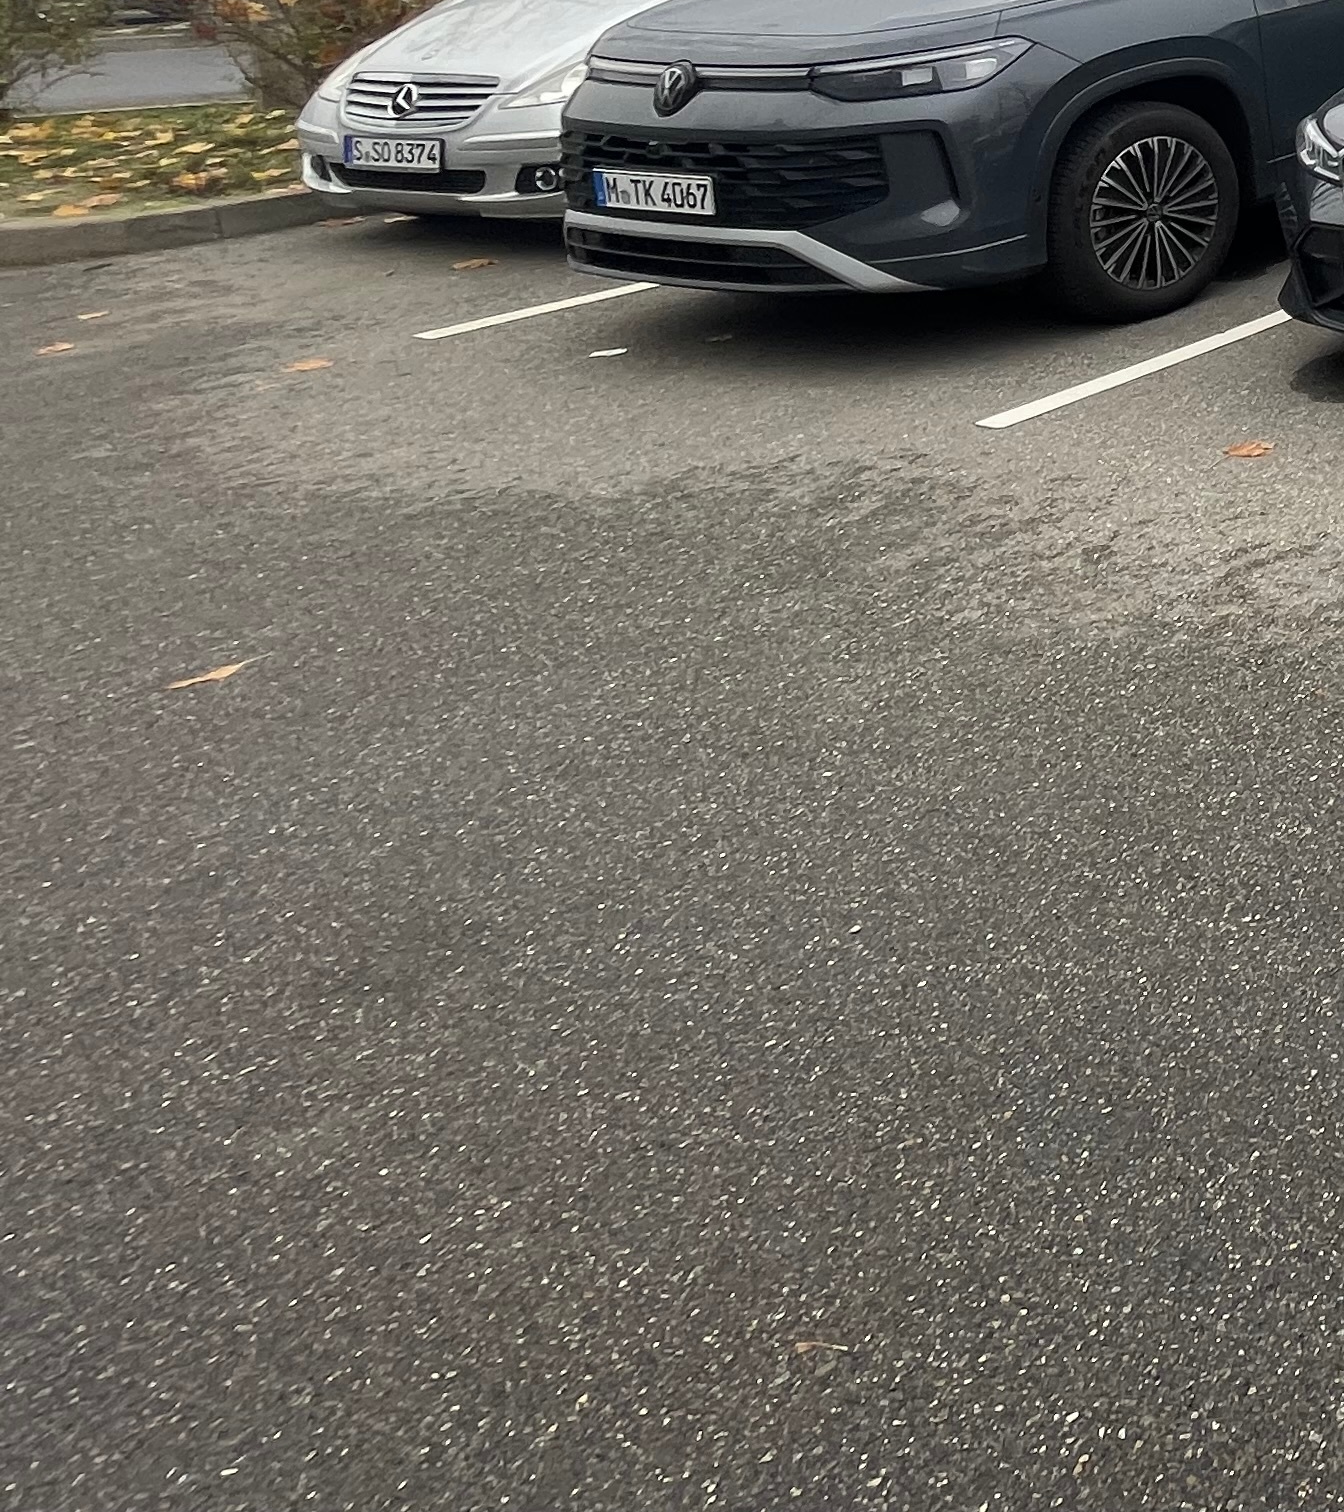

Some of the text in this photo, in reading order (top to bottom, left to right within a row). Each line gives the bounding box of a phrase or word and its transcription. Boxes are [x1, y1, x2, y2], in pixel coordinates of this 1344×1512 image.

[395, 142, 438, 164] 8374
[605, 177, 708, 210] M TK 4067
